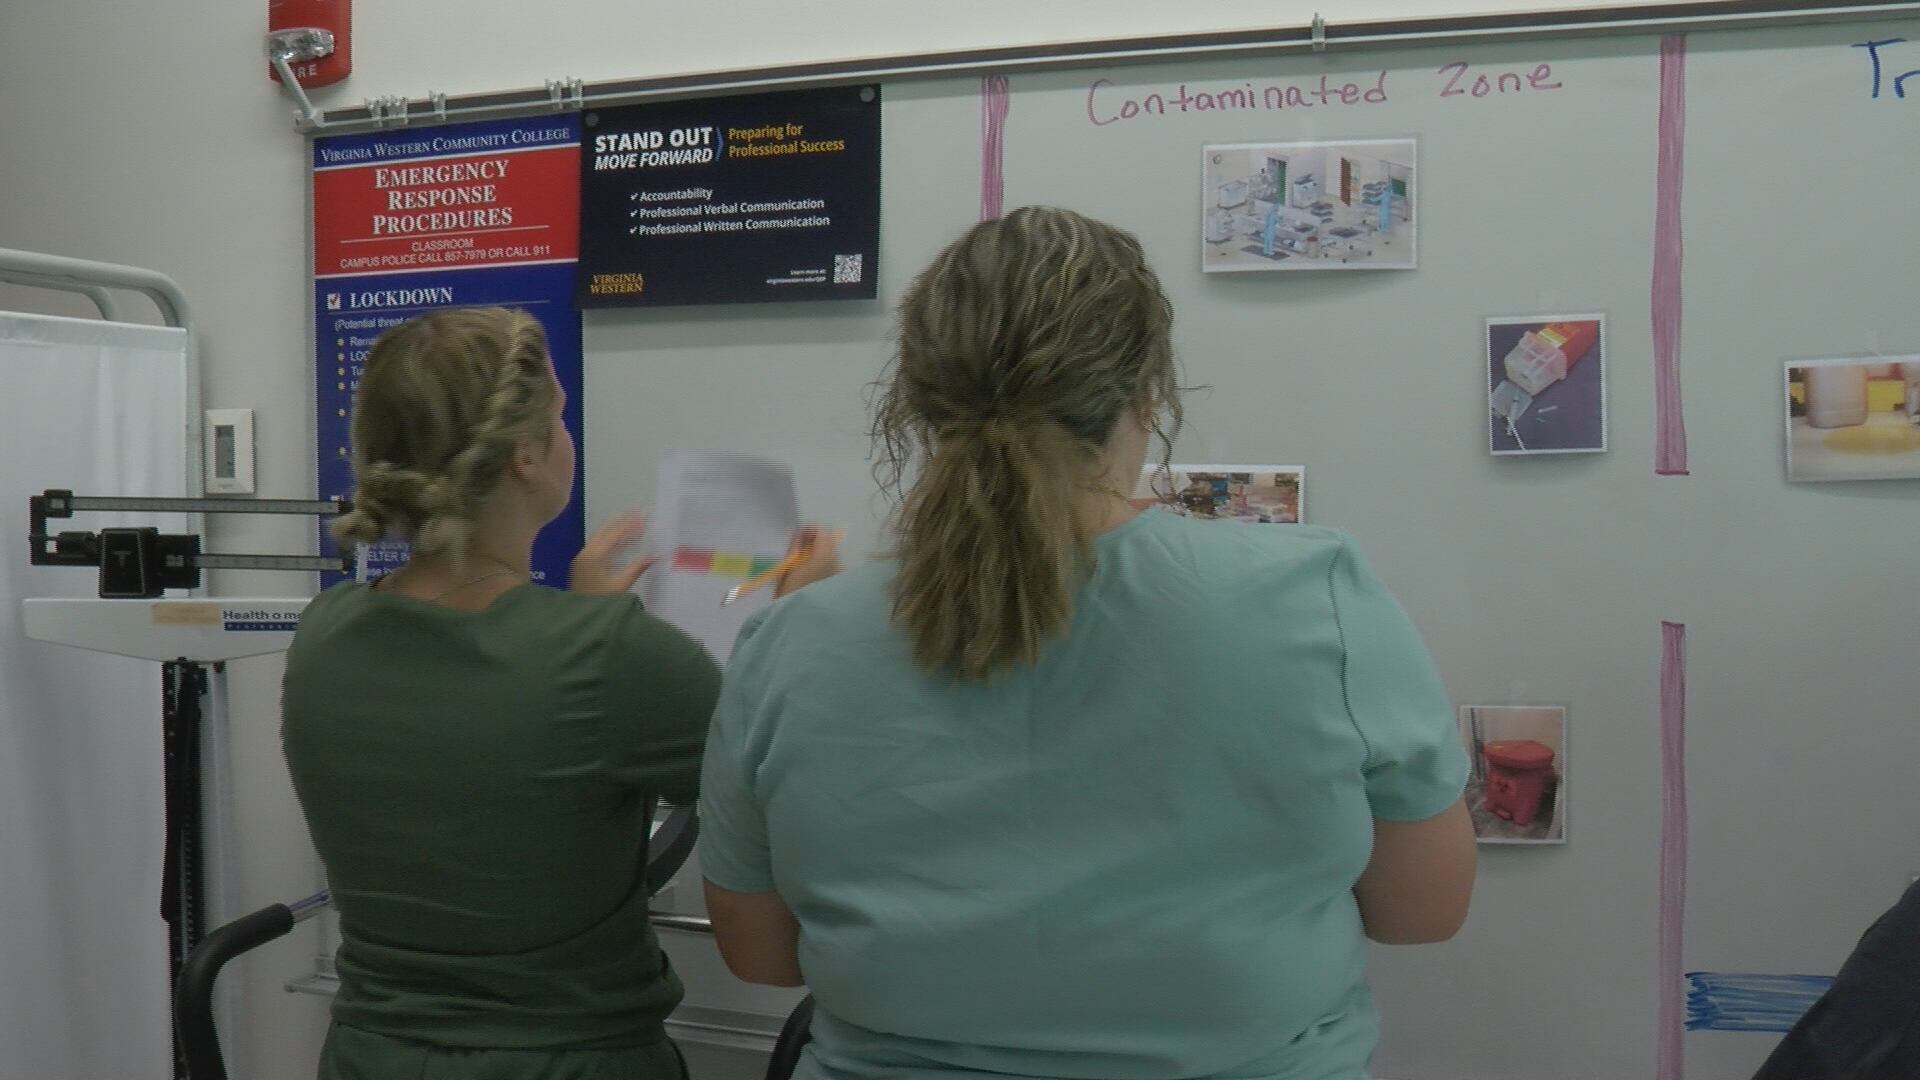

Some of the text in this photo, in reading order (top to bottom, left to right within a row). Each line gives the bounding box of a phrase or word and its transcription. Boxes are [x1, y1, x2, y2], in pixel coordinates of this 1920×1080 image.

[296, 64, 318, 78] RE
[1850, 38, 1920, 98] Tr
[1088, 61, 1563, 126] Contaminated Zone
[595, 126, 713, 154] STAND OUT
[729, 123, 803, 141] Preparing for
[321, 128, 571, 162] VIRGINIA WESTERN COMMUNITY COLLEGE
[729, 139, 845, 158] Professional Success
[594, 149, 713, 171] MOVE FORWARD
[375, 160, 509, 189] EMERGENCY
[388, 185, 497, 210] RESPONSE
[639, 187, 713, 202] Accountability
[639, 198, 825, 219] Professional Verbal Communication
[373, 207, 513, 235] PROCEDURES
[639, 215, 831, 236] Professional Written Communication
[412, 237, 474, 252] CLASSROOM
[340, 257, 380, 269] CAMPUS
[382, 254, 417, 266] POLICE
[419, 251, 443, 263] CALL
[488, 247, 503, 258] OR
[506, 246, 532, 257] CALL
[533, 244, 550, 255] 911
[590, 282, 642, 294] WESTERN
[593, 273, 643, 284] VIRGINIA
[350, 287, 453, 308] LOCKDOWN
[334, 317, 376, 332] (Potential
[350, 350, 369, 361] LOC
[223, 610, 269, 620] Health
